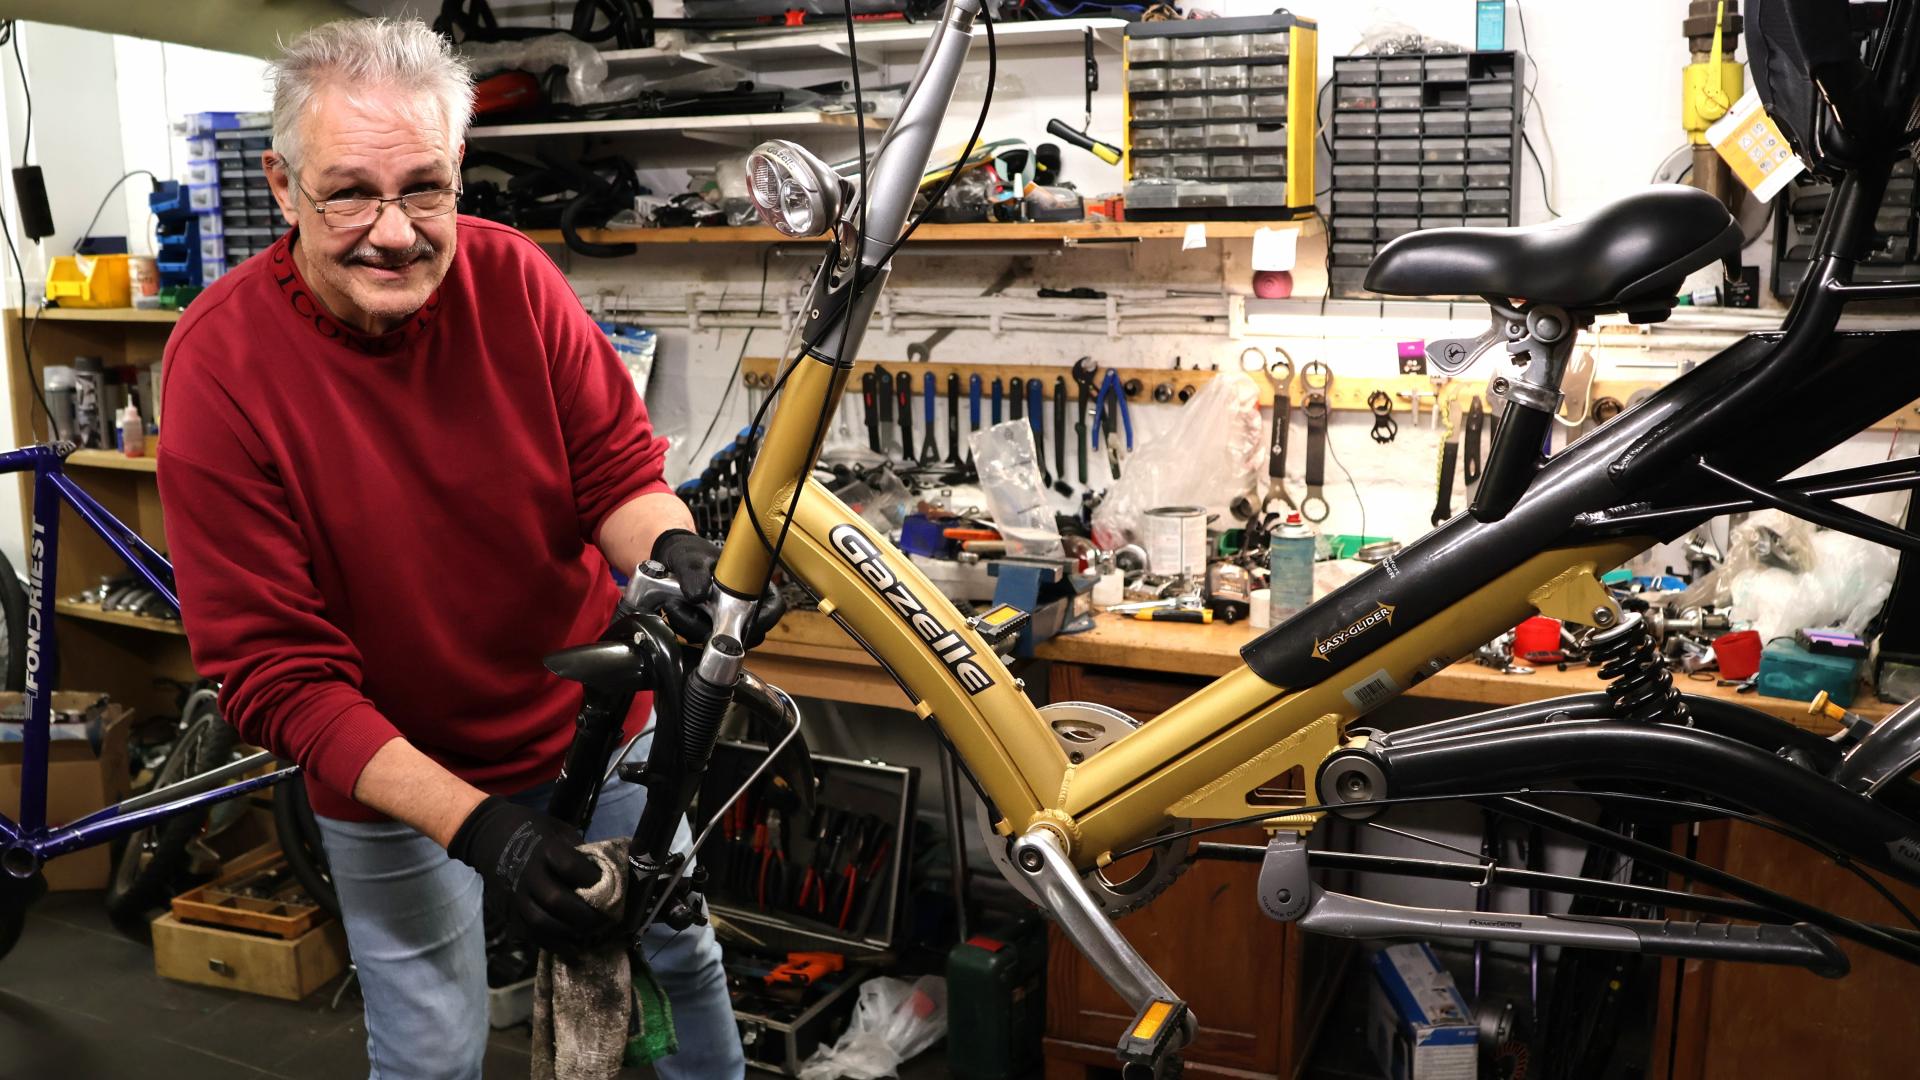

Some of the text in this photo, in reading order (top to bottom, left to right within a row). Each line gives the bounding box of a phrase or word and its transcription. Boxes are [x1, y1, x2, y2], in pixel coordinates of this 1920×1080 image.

[766, 146, 796, 171] Gazelle
[26, 515, 46, 689] FONDRIEST
[830, 525, 993, 694] Gazelle
[1319, 608, 1389, 653] EASY-GLIDER
